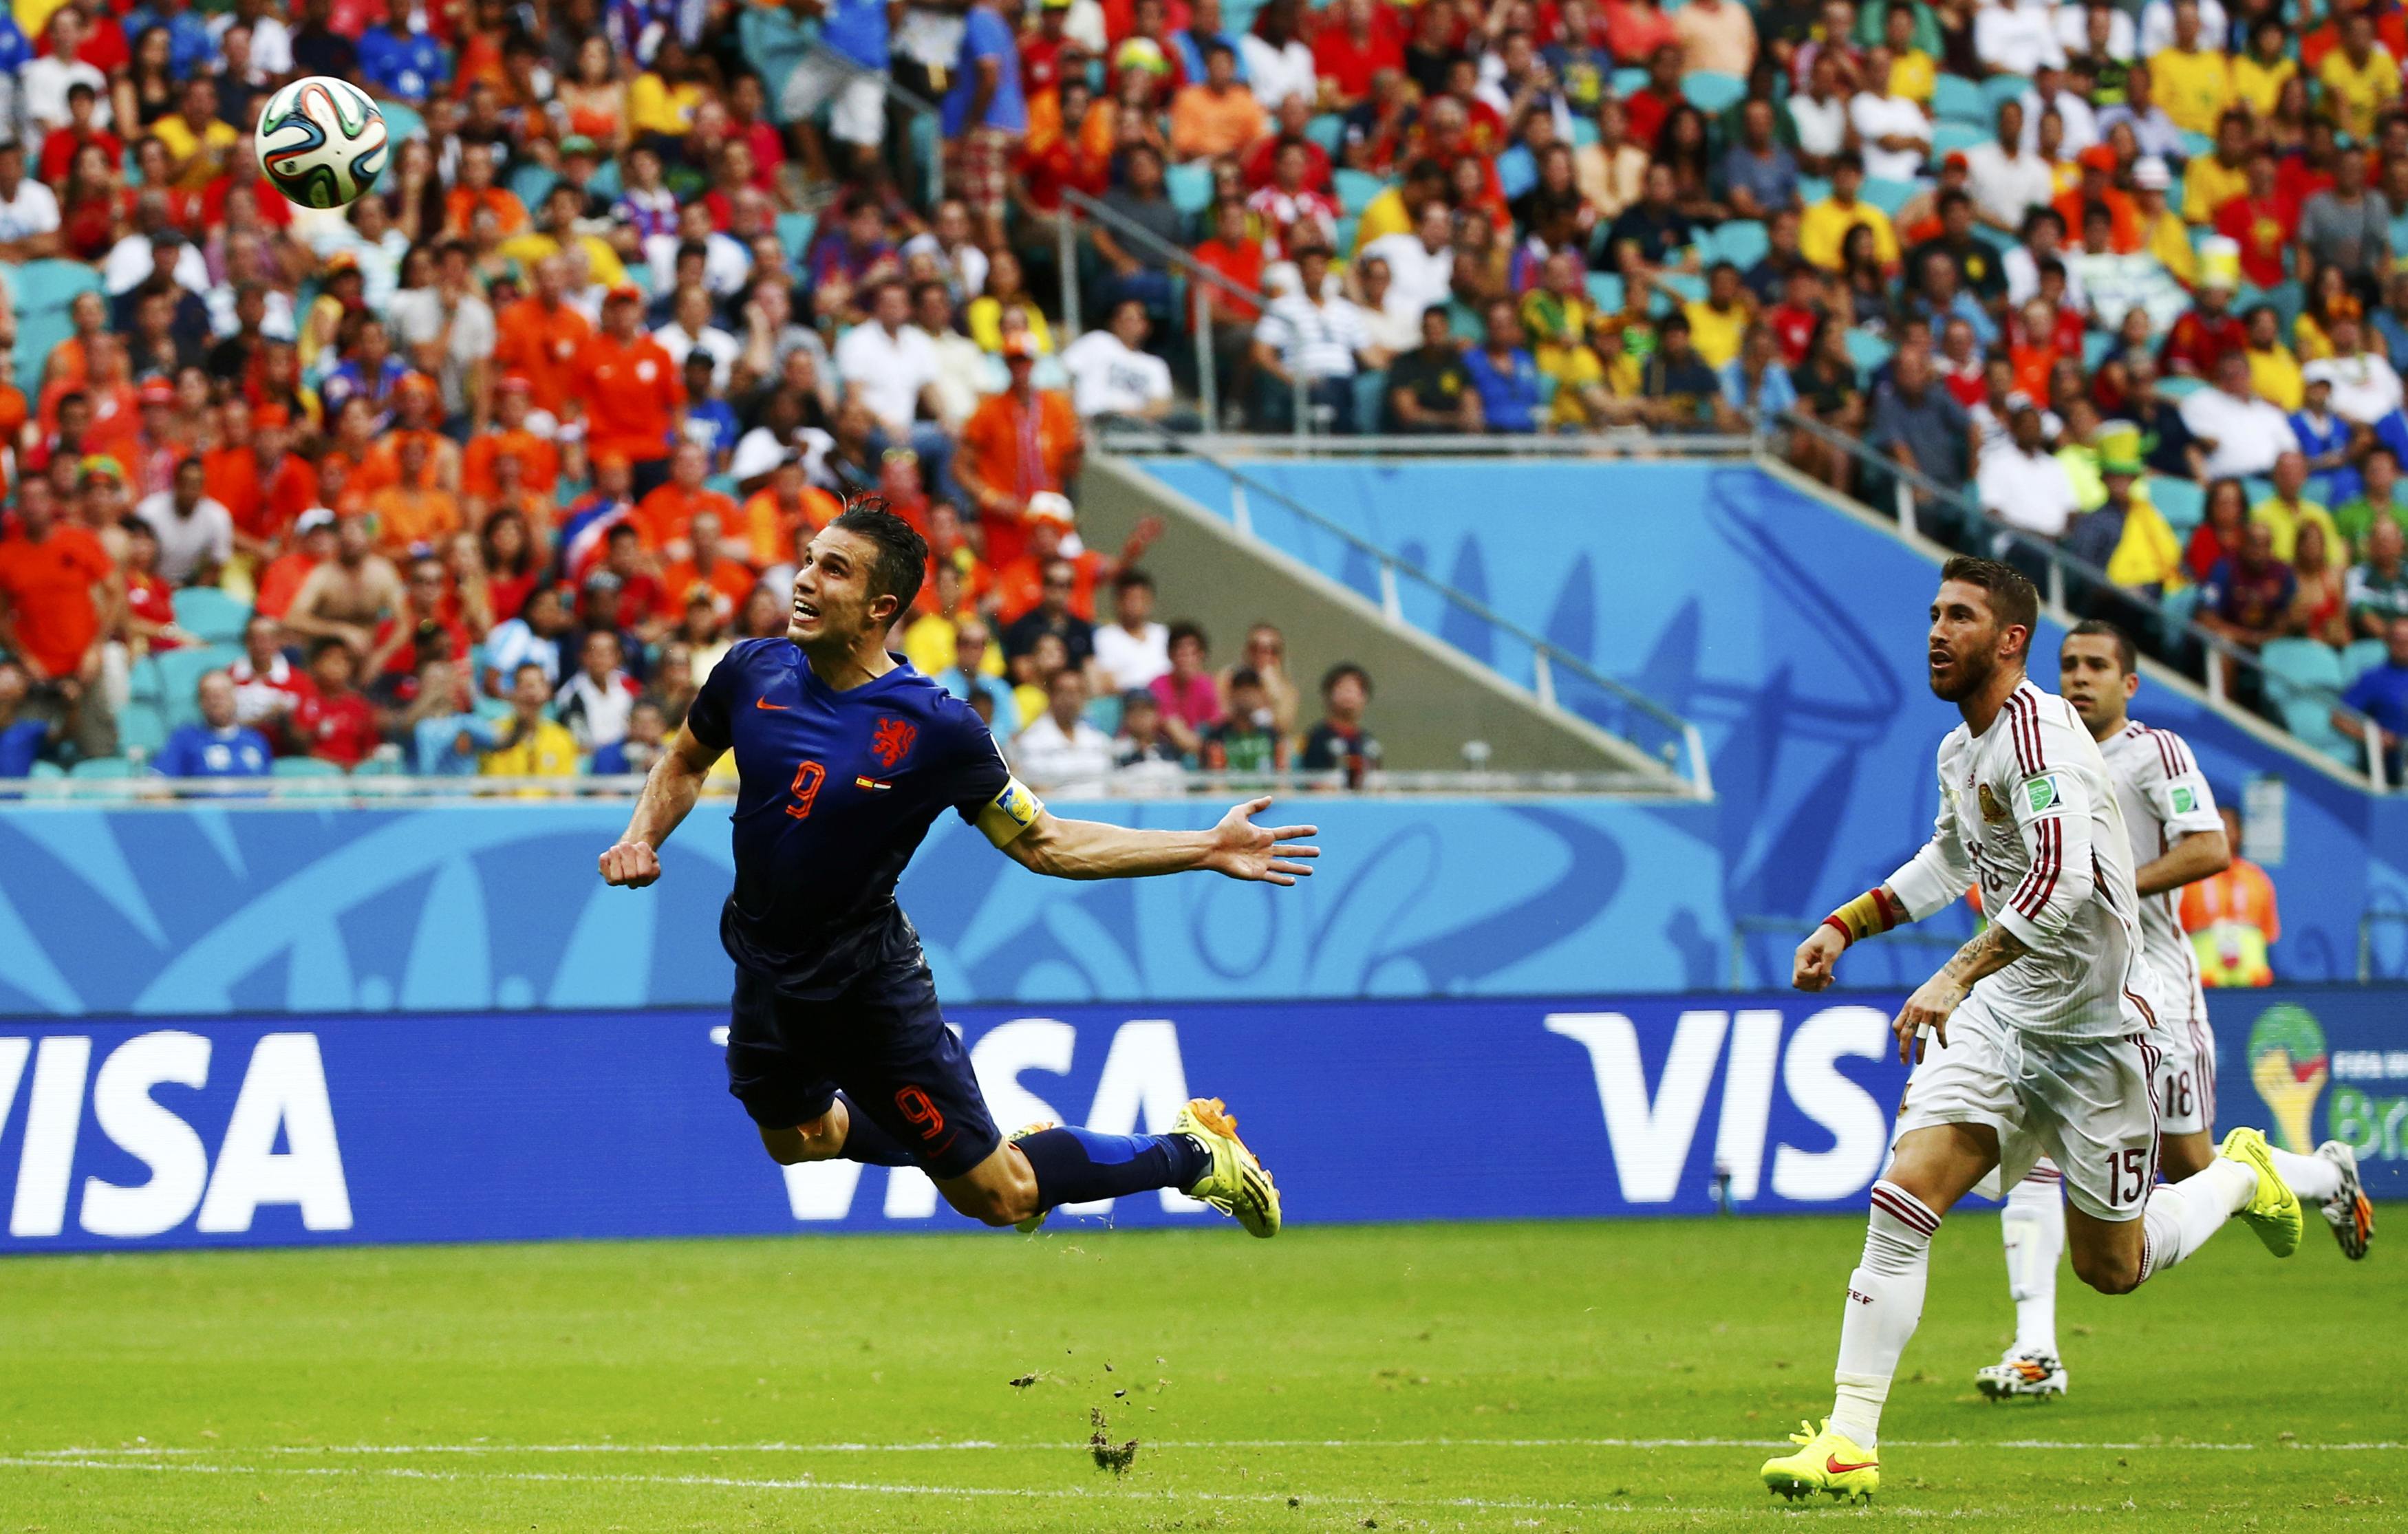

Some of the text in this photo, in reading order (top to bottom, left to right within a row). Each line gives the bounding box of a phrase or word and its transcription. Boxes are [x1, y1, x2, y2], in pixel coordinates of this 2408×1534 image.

[785, 759, 826, 819] 9
[710, 1018, 1210, 1220] SA
[895, 1085, 943, 1140] 9
[1544, 1005, 1895, 1202] VIS
[2166, 1071, 2193, 1118] 18
[0, 1030, 354, 1238] ISA
[2106, 1148, 2146, 1207] 15
